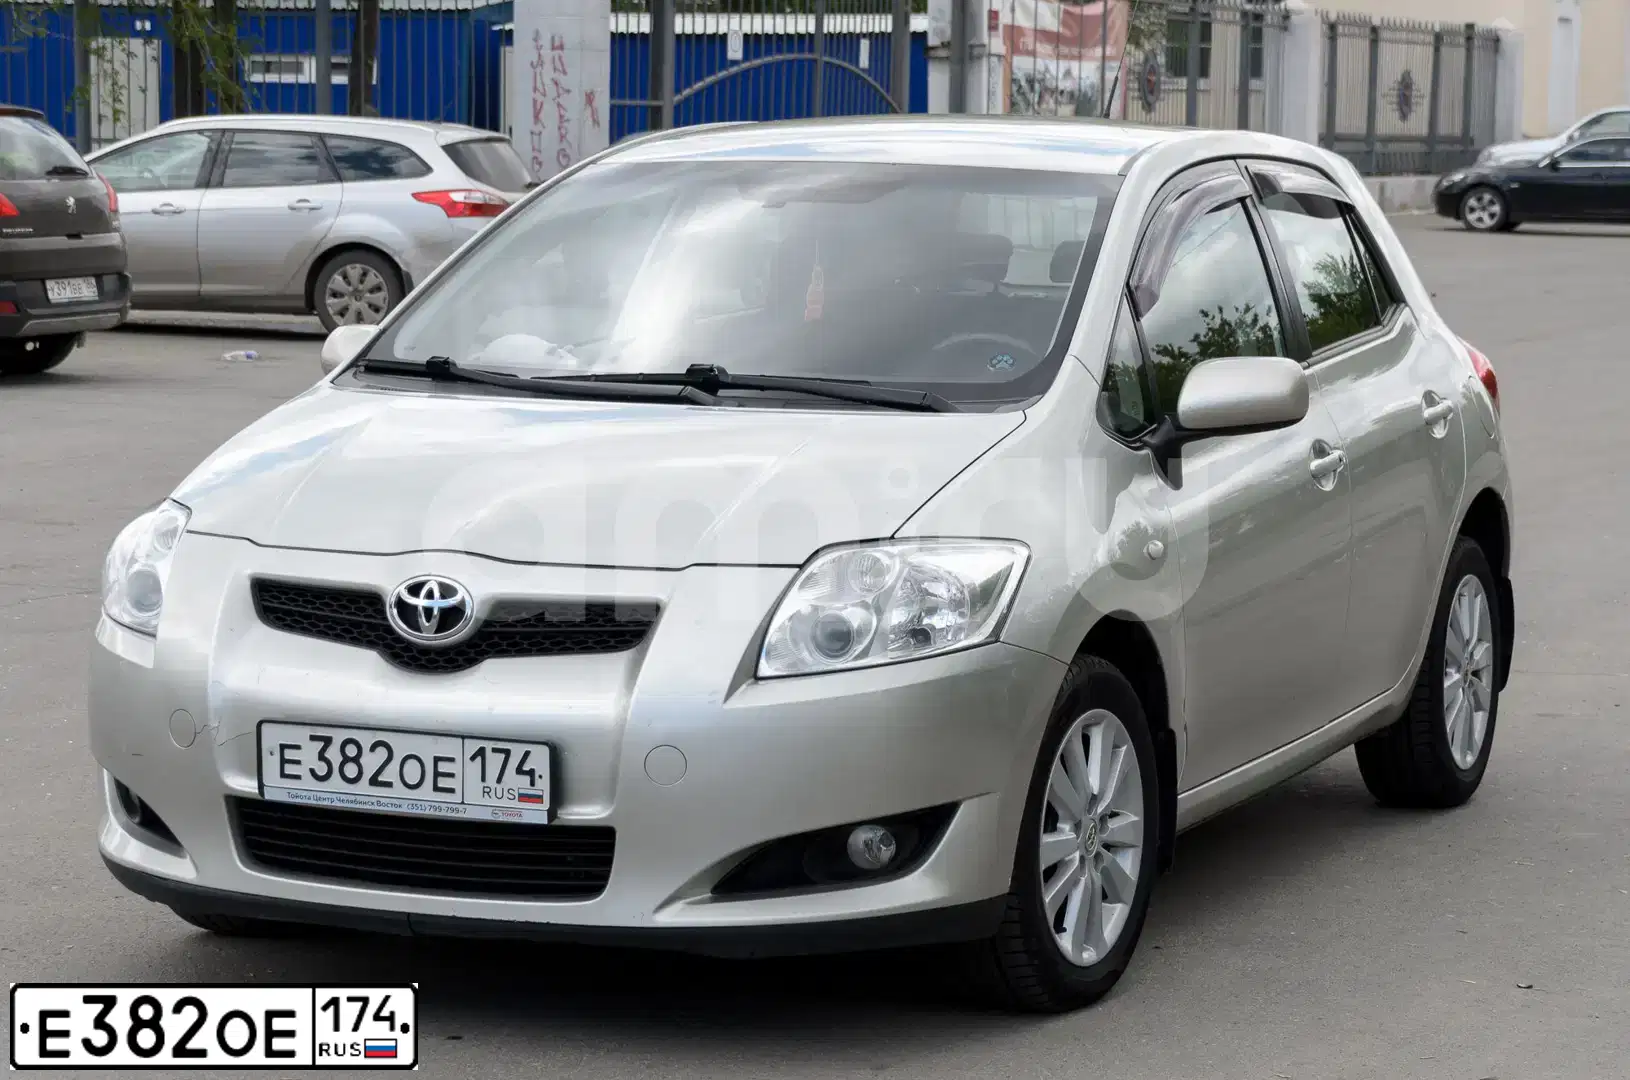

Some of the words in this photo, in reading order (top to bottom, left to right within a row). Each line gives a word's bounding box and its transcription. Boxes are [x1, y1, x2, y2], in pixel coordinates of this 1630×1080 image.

[469, 746, 536, 787] 174
[287, 791, 311, 801] Тойота
[312, 794, 335, 804] Центр
[336, 796, 376, 807] Челябинск
[376, 801, 403, 809] Восток
[406, 803, 428, 812] (351)
[428, 805, 468, 815] 799-799-7
[482, 785, 516, 801] RUS
